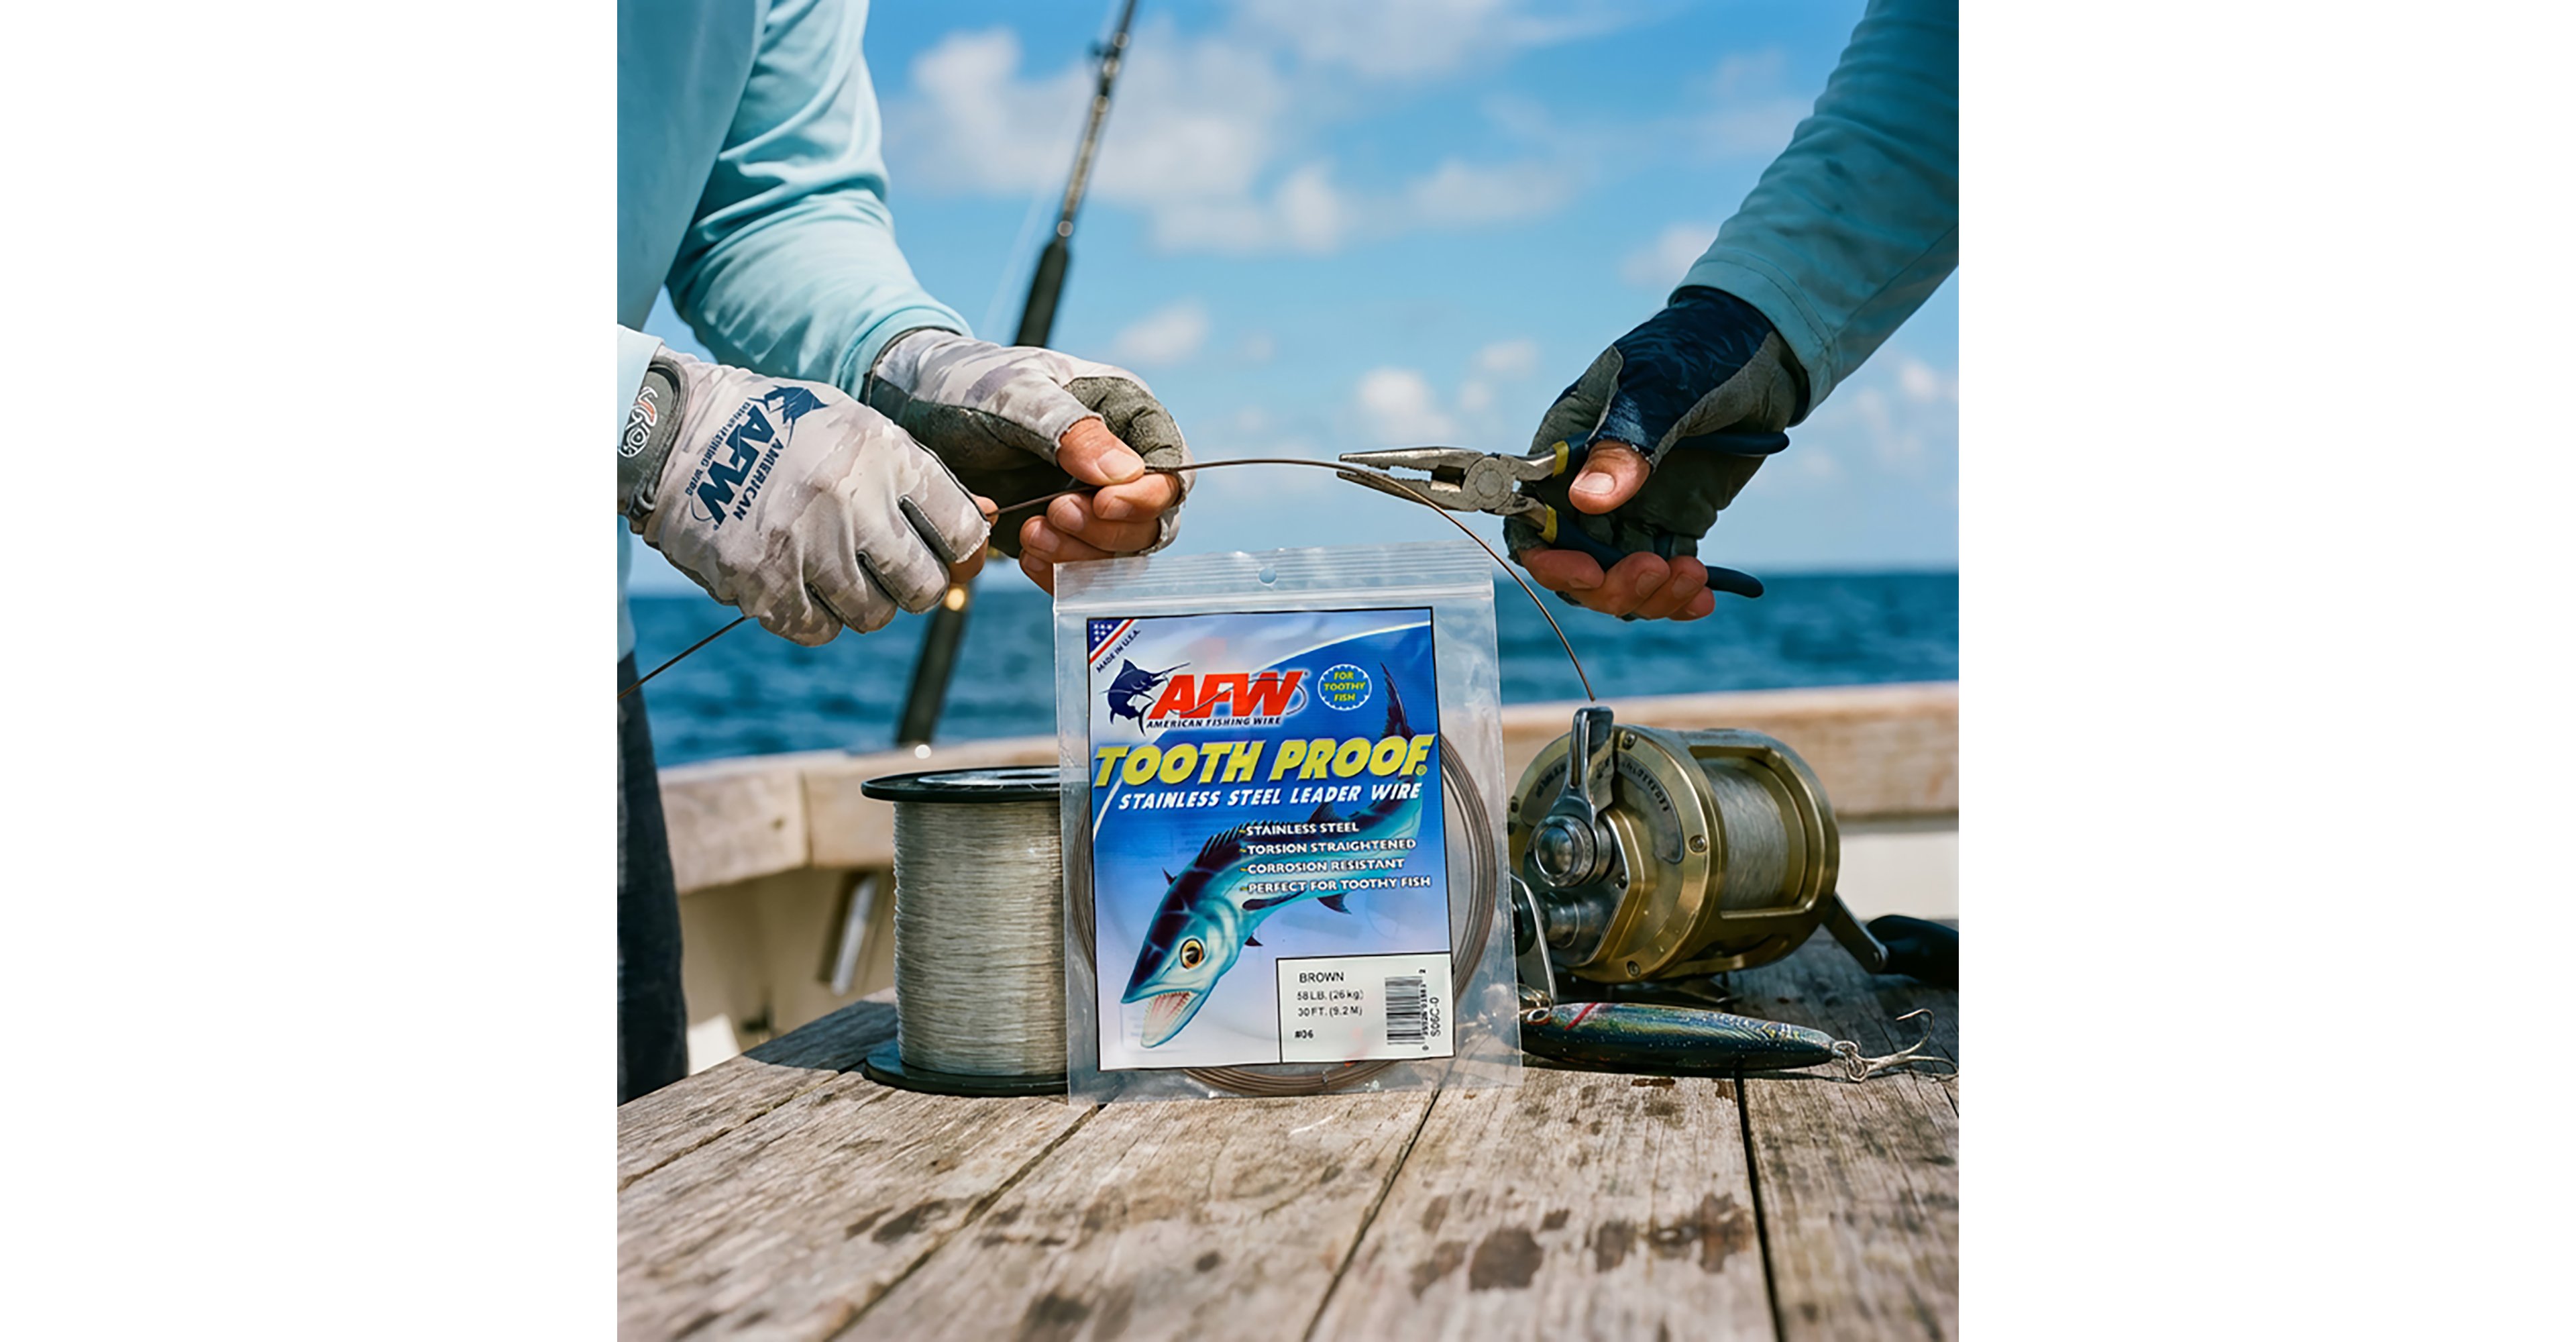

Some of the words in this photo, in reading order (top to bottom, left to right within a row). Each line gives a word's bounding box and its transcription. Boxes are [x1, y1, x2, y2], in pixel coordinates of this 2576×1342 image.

[697, 405, 775, 525] AFW
[733, 437, 784, 521] AMERICAN
[1096, 652, 1116, 673] MADE
[1114, 645, 1124, 655] IN
[1334, 670, 1354, 680] FOR
[1324, 680, 1366, 691] TOOTHY
[1147, 671, 1304, 720] AFW
[1334, 692, 1356, 702] FISH
[1146, 719, 1203, 729] AMERICAN
[1207, 717, 1250, 727] FISHING
[1253, 716, 1282, 725] WIRE
[1093, 739, 1267, 788] TOOTH
[1267, 733, 1437, 782] PROOF
[1118, 790, 1222, 810] STAINLESS
[1227, 788, 1282, 807] STEEL
[1289, 784, 1362, 805] LEADER
[1371, 782, 1423, 801] WIRE
[1320, 822, 1360, 833] STEEL
[1310, 839, 1417, 852] STRAIGHTENED
[1330, 858, 1405, 872] RESISTANT
[1310, 880, 1338, 891] FOR
[1340, 877, 1397, 890] TOOTHY
[1401, 876, 1431, 887] FISH
[1299, 972, 1344, 983] BROWN
